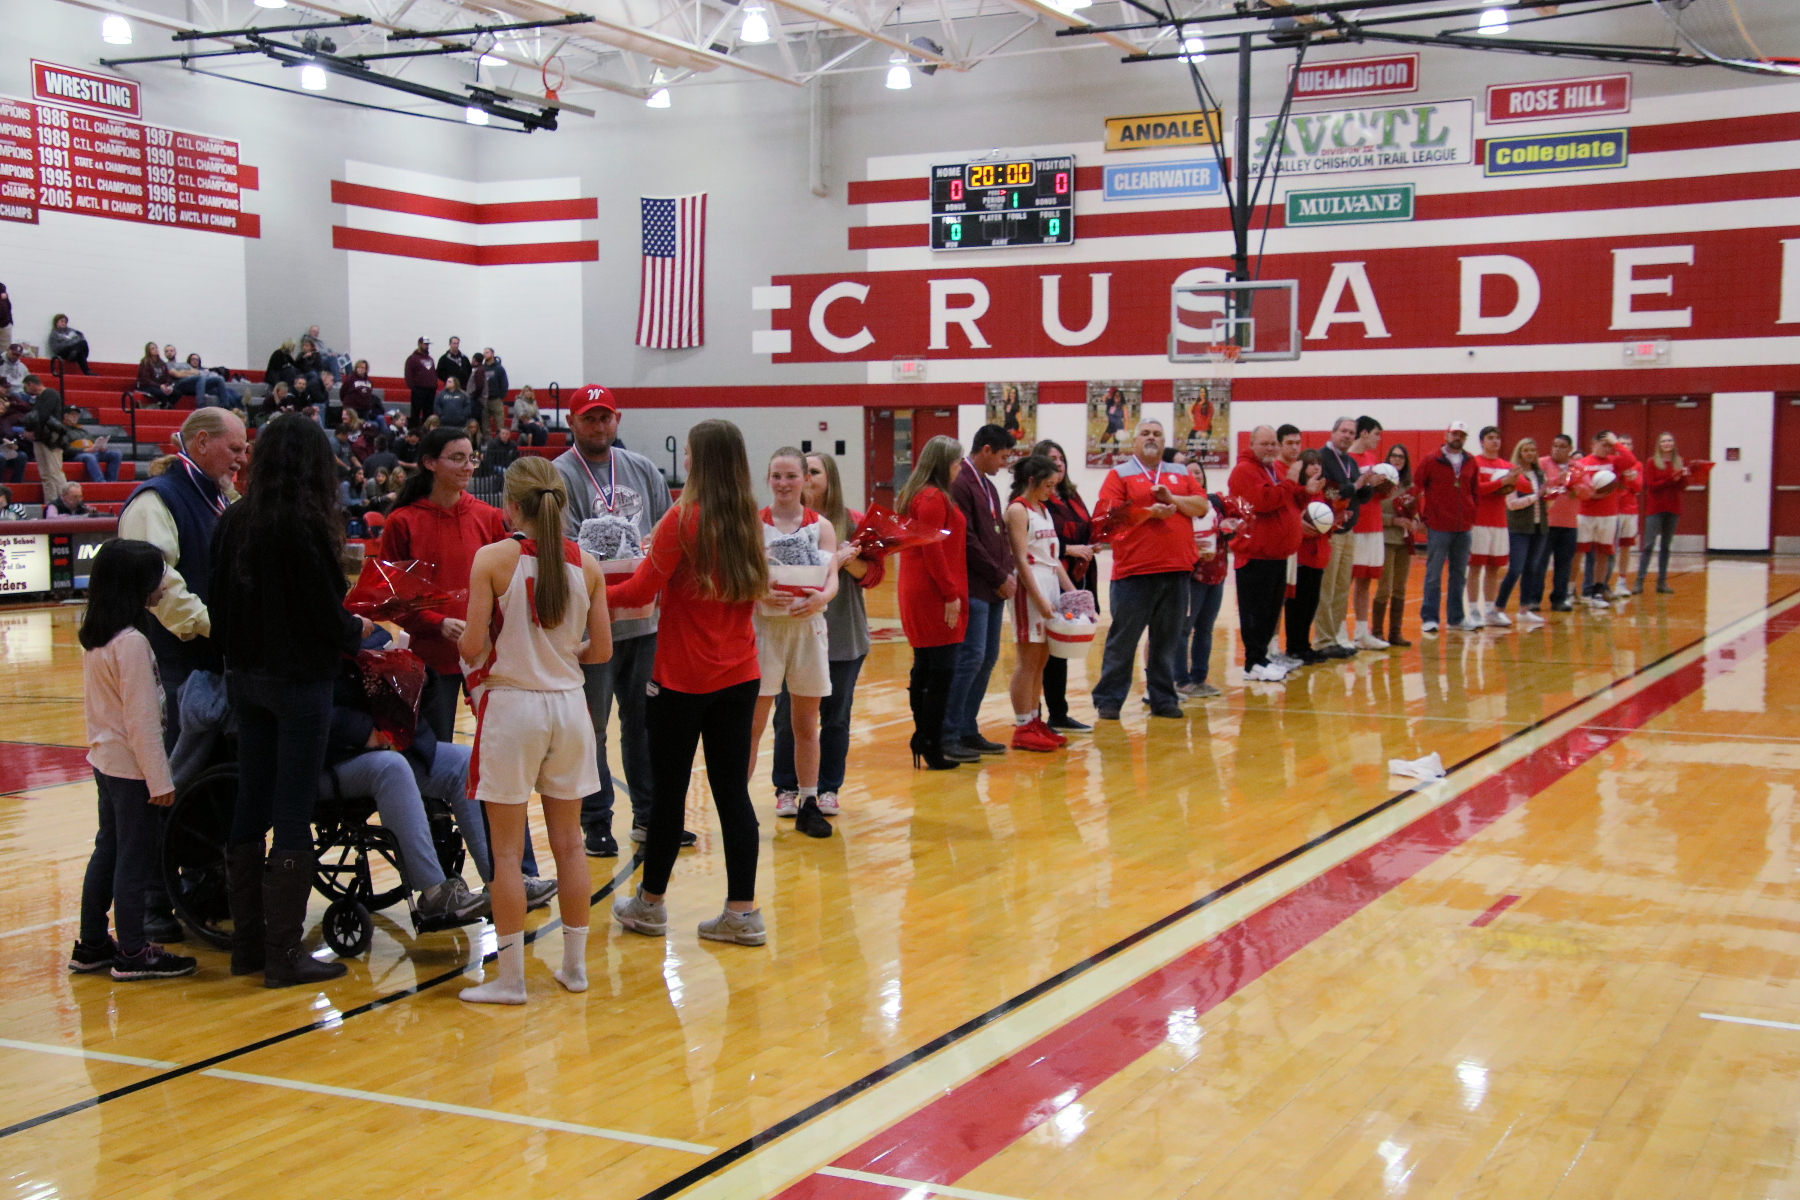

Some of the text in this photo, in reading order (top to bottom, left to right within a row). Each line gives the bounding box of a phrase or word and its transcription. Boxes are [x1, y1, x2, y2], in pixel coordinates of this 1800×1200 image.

[44, 70, 131, 109] WRESTLING
[1297, 63, 1408, 92] WELLINGTON
[1509, 84, 1606, 113] ROSE HILL
[36, 106, 69, 129] 1986
[93, 121, 140, 141] CHAMPIONS
[1120, 120, 1204, 142] ANDALE
[1253, 106, 1449, 160] AVCTL
[37, 126, 70, 149] 1989
[94, 140, 141, 160] CHAMPIONS
[144, 127, 174, 147] 1987
[195, 140, 237, 158] CHAMPIONS
[1496, 141, 1616, 165] Collegiate
[38, 146, 69, 168] 1991
[74, 156, 94, 168] STATE
[105, 161, 142, 177] CHAMPIONS
[145, 146, 175, 167] 1990
[196, 159, 238, 176] CHAMPIONS
[1036, 159, 1070, 171] VISITOR
[1314, 154, 1374, 170] CHISHOLM
[1413, 148, 1457, 163] LEAGUE
[39, 167, 72, 189] 1995
[97, 178, 144, 197] CHAMPIONS
[146, 165, 175, 186] 1992
[197, 177, 238, 194] CHAMPIONS
[936, 166, 961, 177] HOME
[971, 163, 1031, 187] 20:00
[1055, 172, 1068, 194] 0
[1114, 167, 1210, 191] CLEARWATER
[1, 184, 35, 200] CHAMPS
[40, 187, 73, 209] 2005
[111, 200, 144, 216] CHAMPS
[147, 184, 176, 204] 1996
[198, 194, 239, 211] CHAMPIONS
[950, 179, 963, 201] 0
[0, 204, 32, 219] CHAMPS
[147, 203, 177, 223] 2016
[210, 214, 237, 228] CHAMPS
[1298, 194, 1403, 216] MULVANE
[950, 223, 962, 241] 0
[1048, 218, 1060, 236] 0
